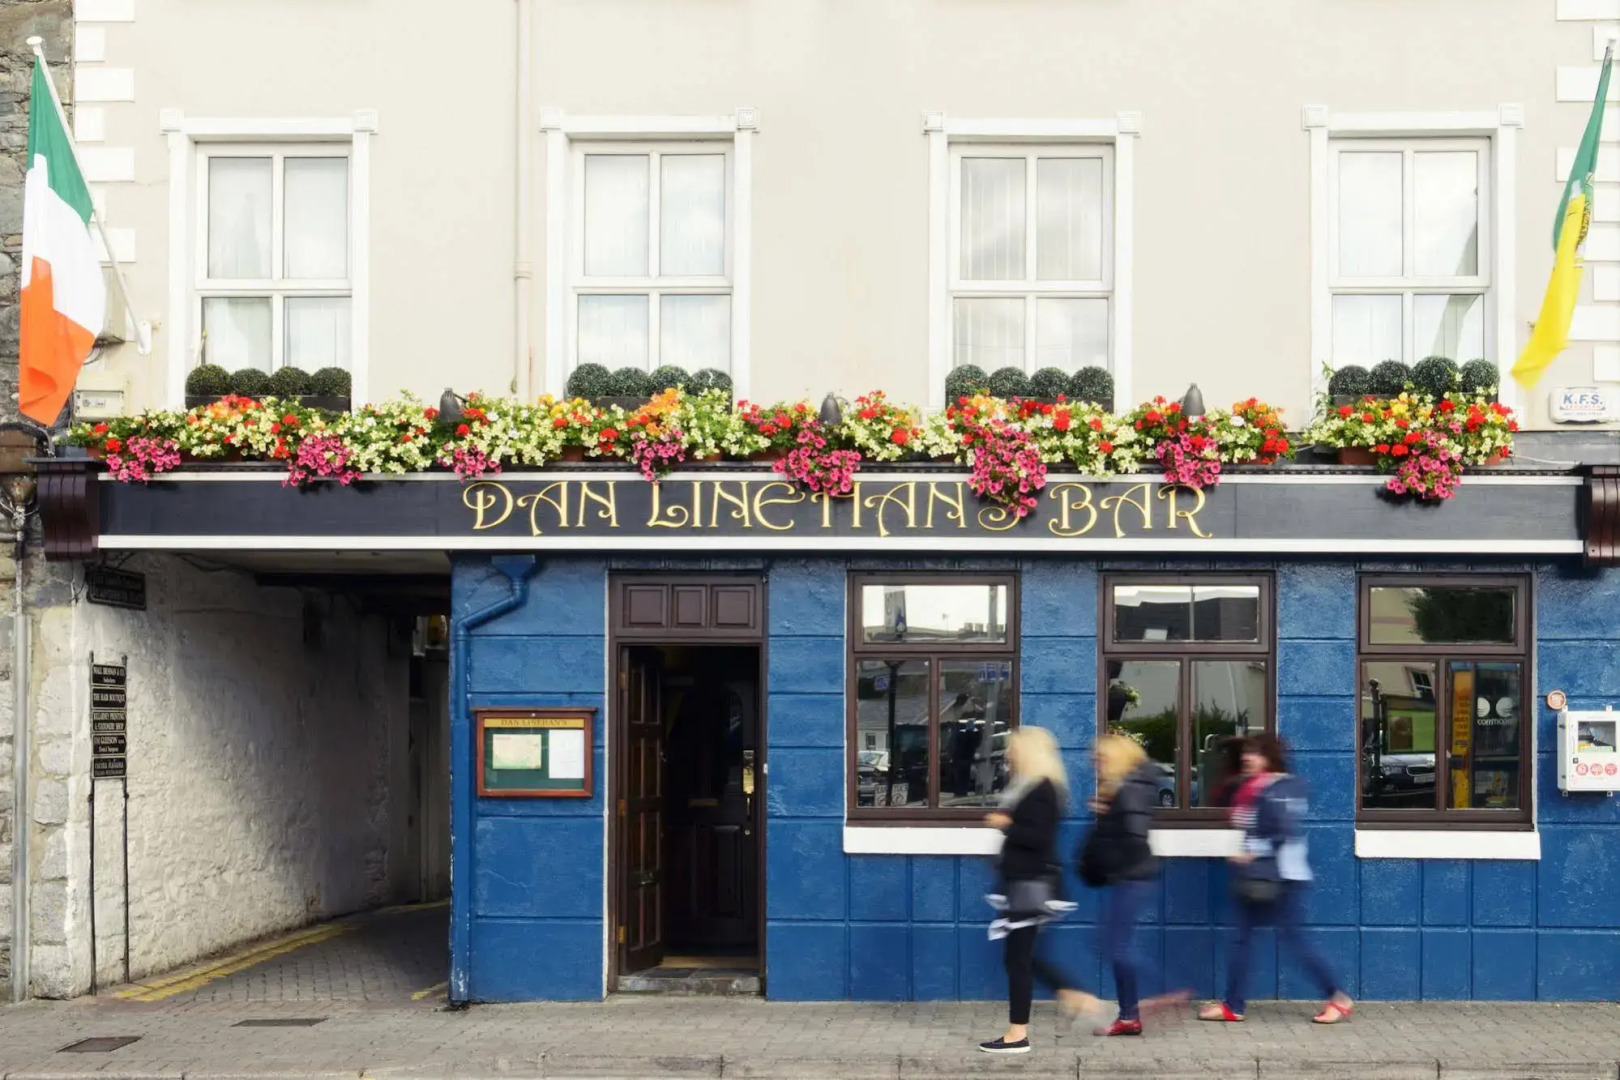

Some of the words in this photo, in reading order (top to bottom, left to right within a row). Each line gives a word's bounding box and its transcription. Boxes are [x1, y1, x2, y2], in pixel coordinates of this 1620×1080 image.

[1563, 394, 1603, 405] K.F.S.
[463, 481, 619, 537] DAN
[1048, 483, 1213, 538] BAR
